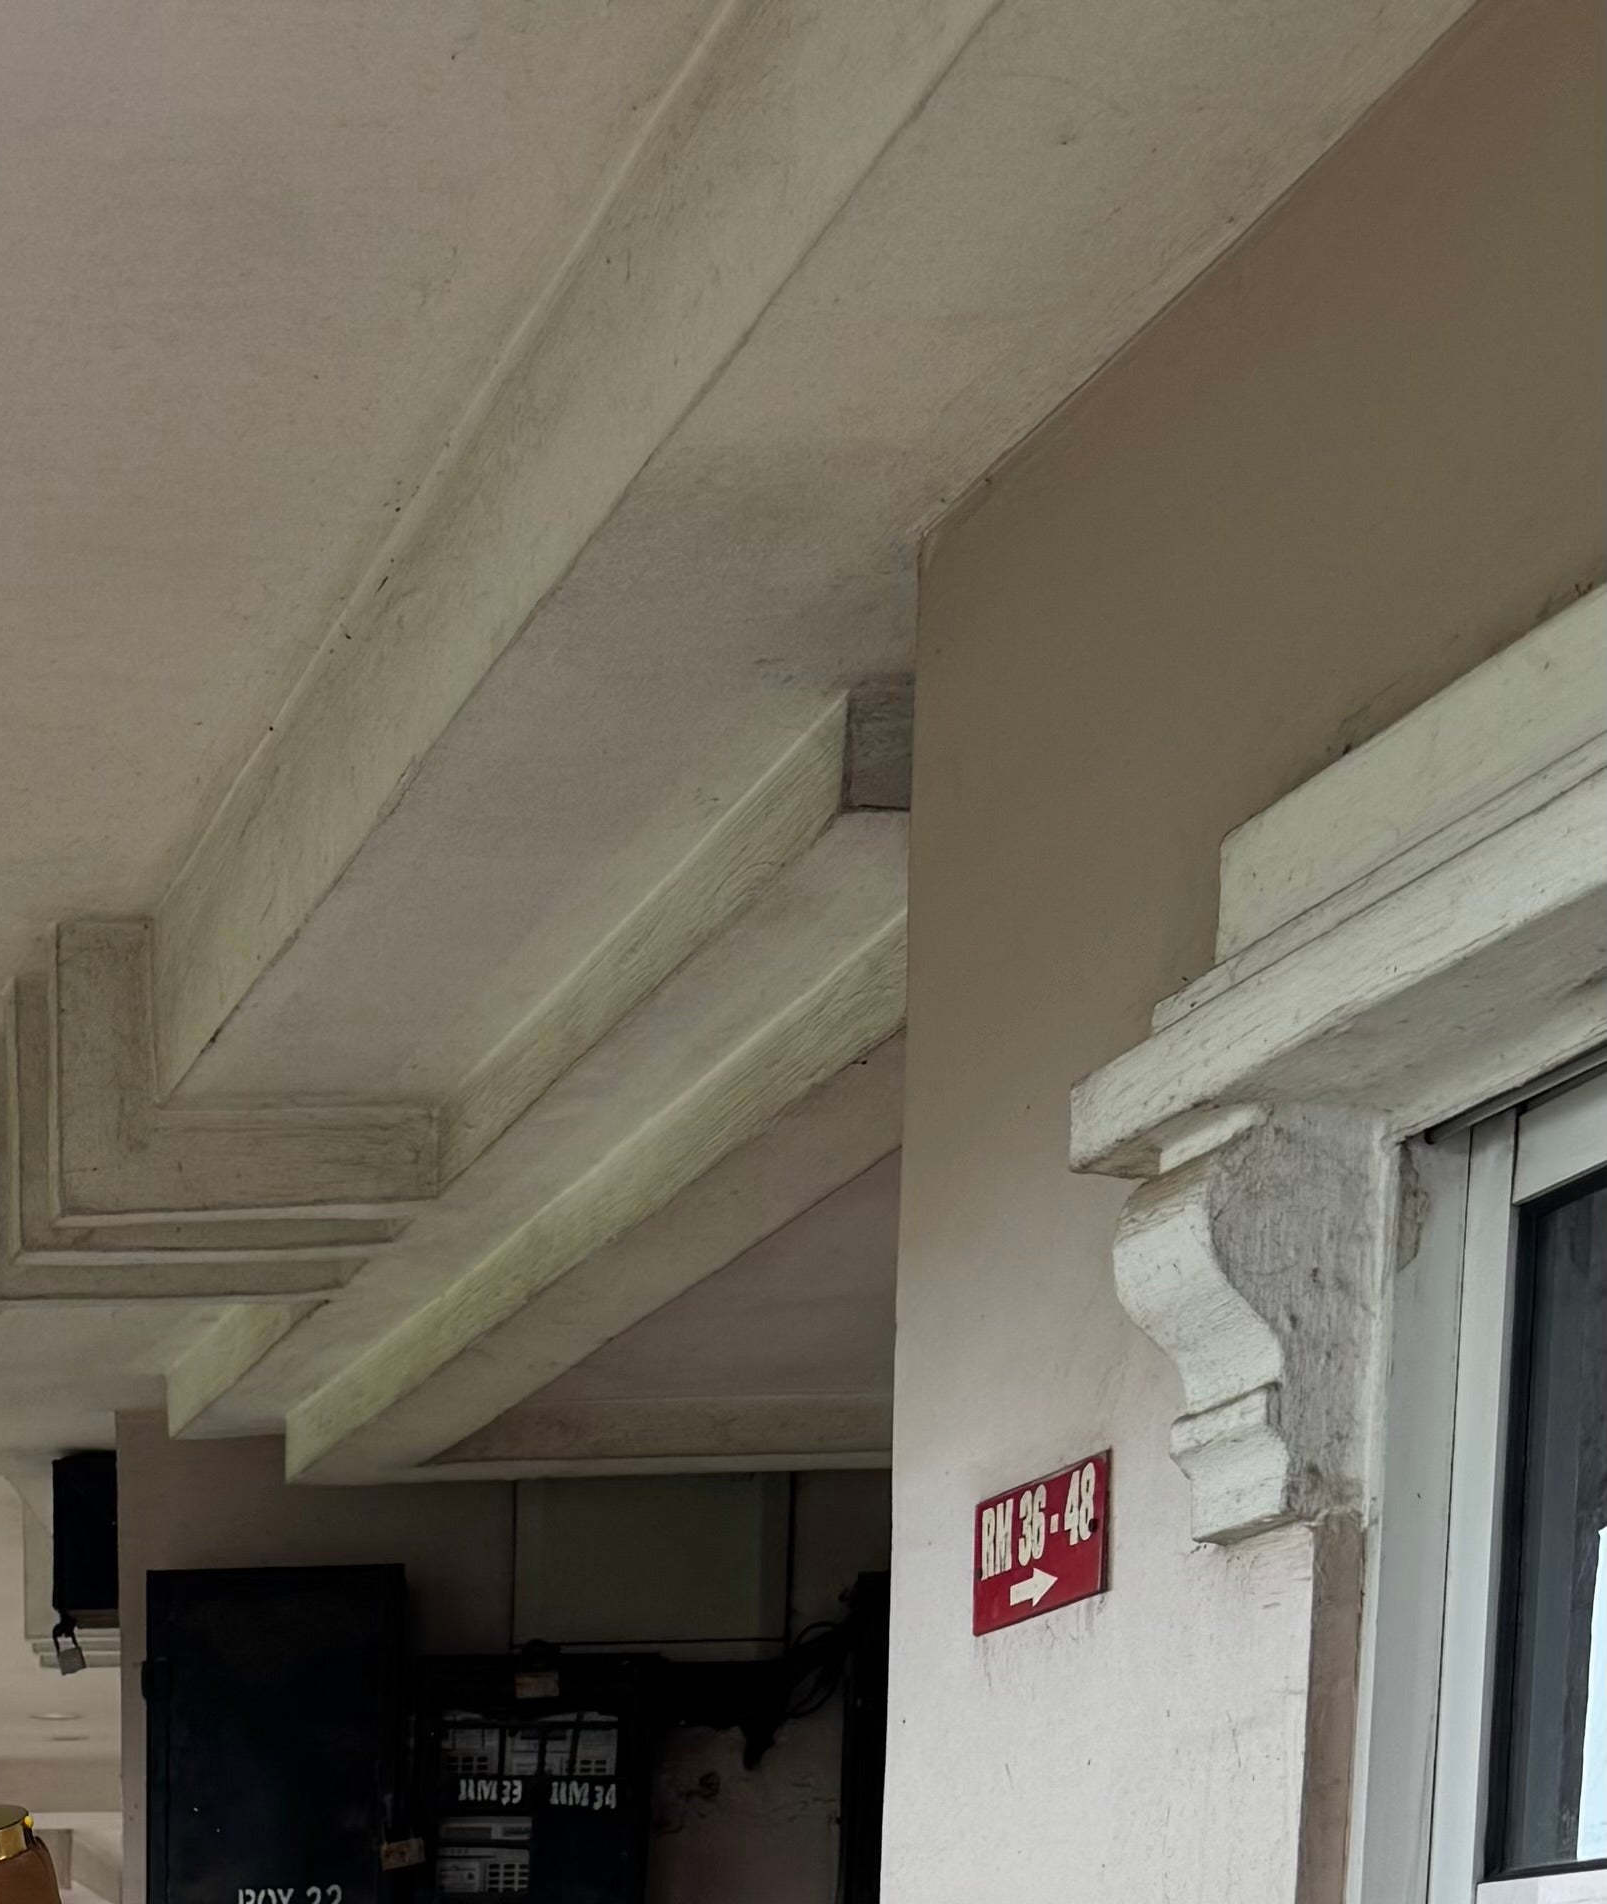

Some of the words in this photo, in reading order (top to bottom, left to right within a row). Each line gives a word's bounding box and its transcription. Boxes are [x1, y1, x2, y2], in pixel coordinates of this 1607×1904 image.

[981, 1498, 1014, 1581] RM
[1018, 1484, 1047, 1567] 36
[1064, 1462, 1096, 1546] 48
[501, 1780, 522, 1805] 33
[593, 1784, 616, 1810] 34
